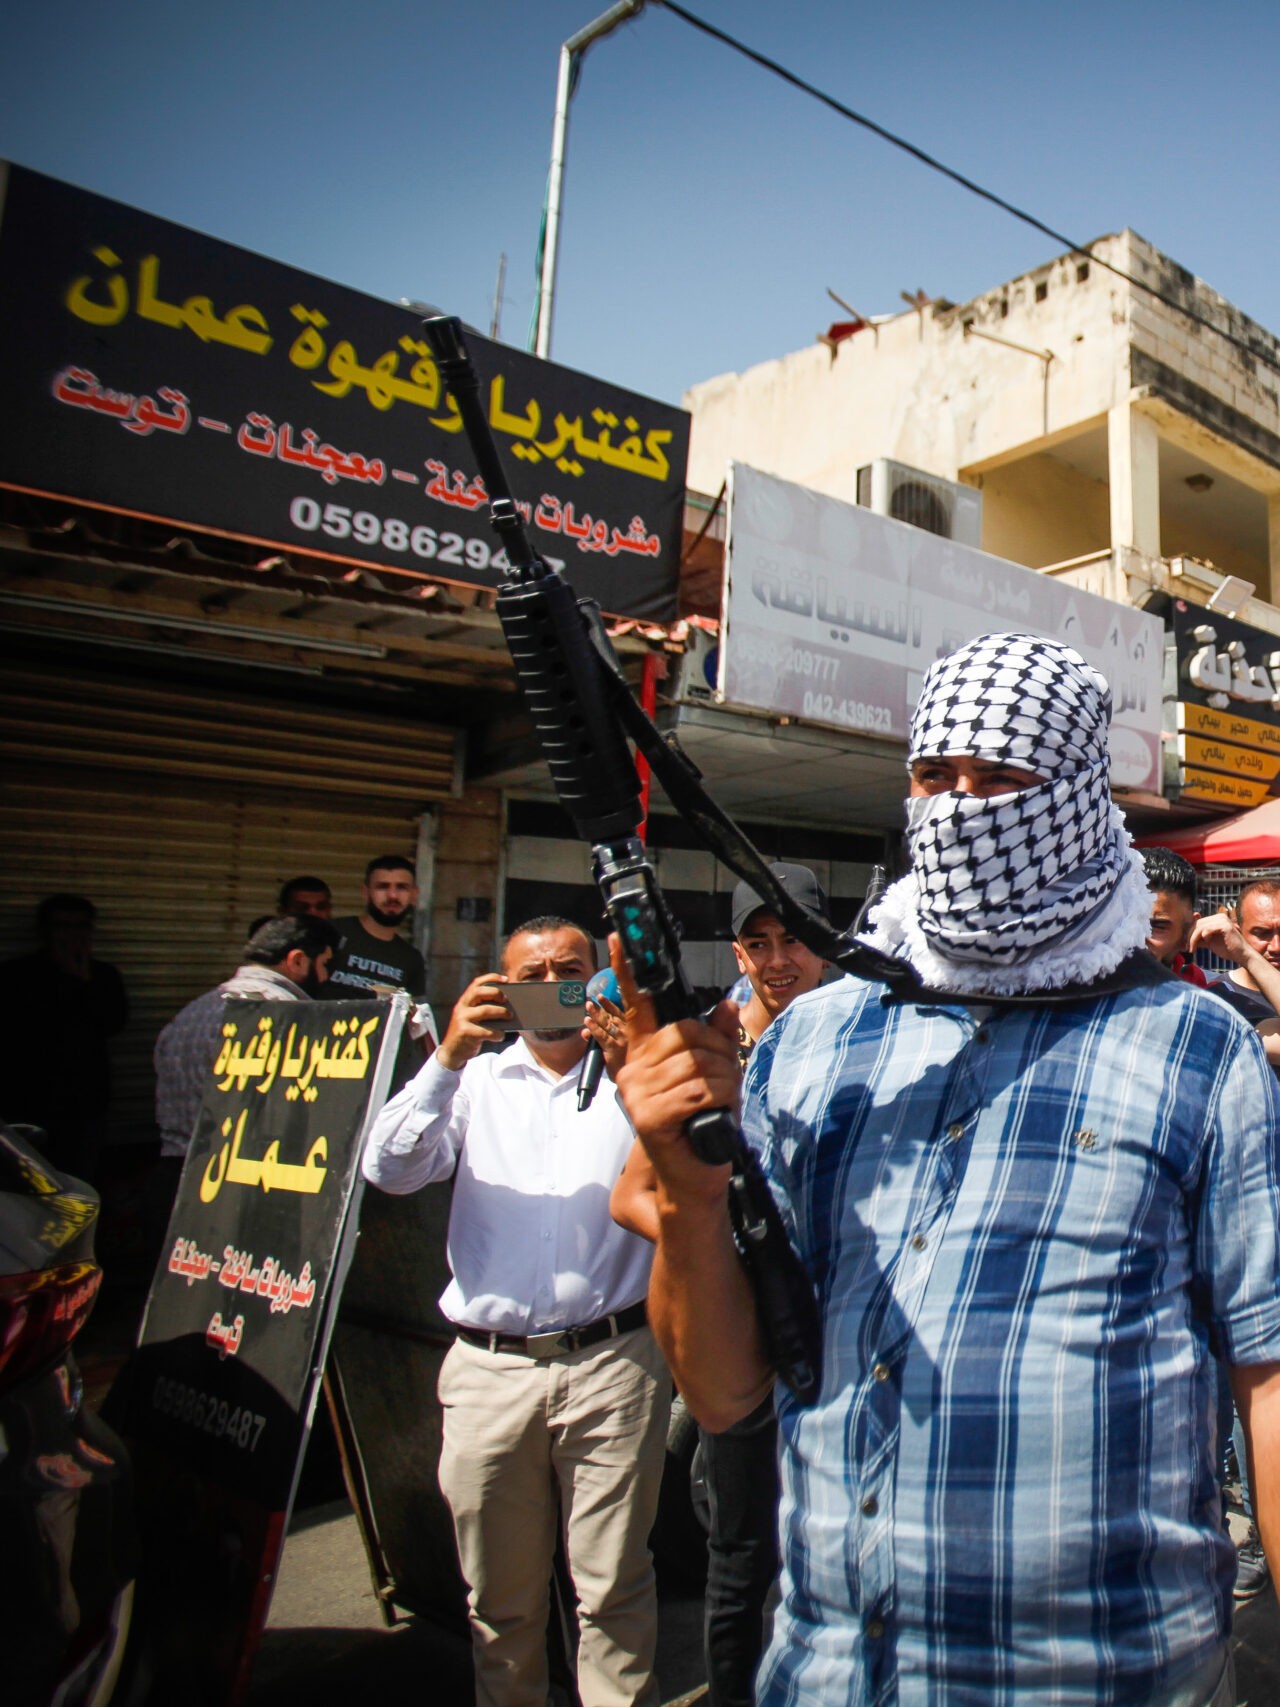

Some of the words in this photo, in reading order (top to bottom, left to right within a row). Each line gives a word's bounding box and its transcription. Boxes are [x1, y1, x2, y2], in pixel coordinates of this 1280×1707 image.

[66, 246, 273, 356] عمان
[53, 365, 191, 437] توست
[289, 303, 464, 433] وقهوة
[238, 411, 388, 486] معجنات
[488, 373, 673, 482] كفتيريا
[424, 458, 532, 525] سخنة
[534, 493, 662, 558] مشروبات
[347, 954, 404, 982] FUTURE
[213, 1016, 281, 1094] وقهوة
[280, 1016, 379, 1102] كفتيريا
[199, 1108, 328, 1203] عمان
[219, 1245, 260, 1295] ساخنة
[256, 1256, 316, 1314] مشروبات
